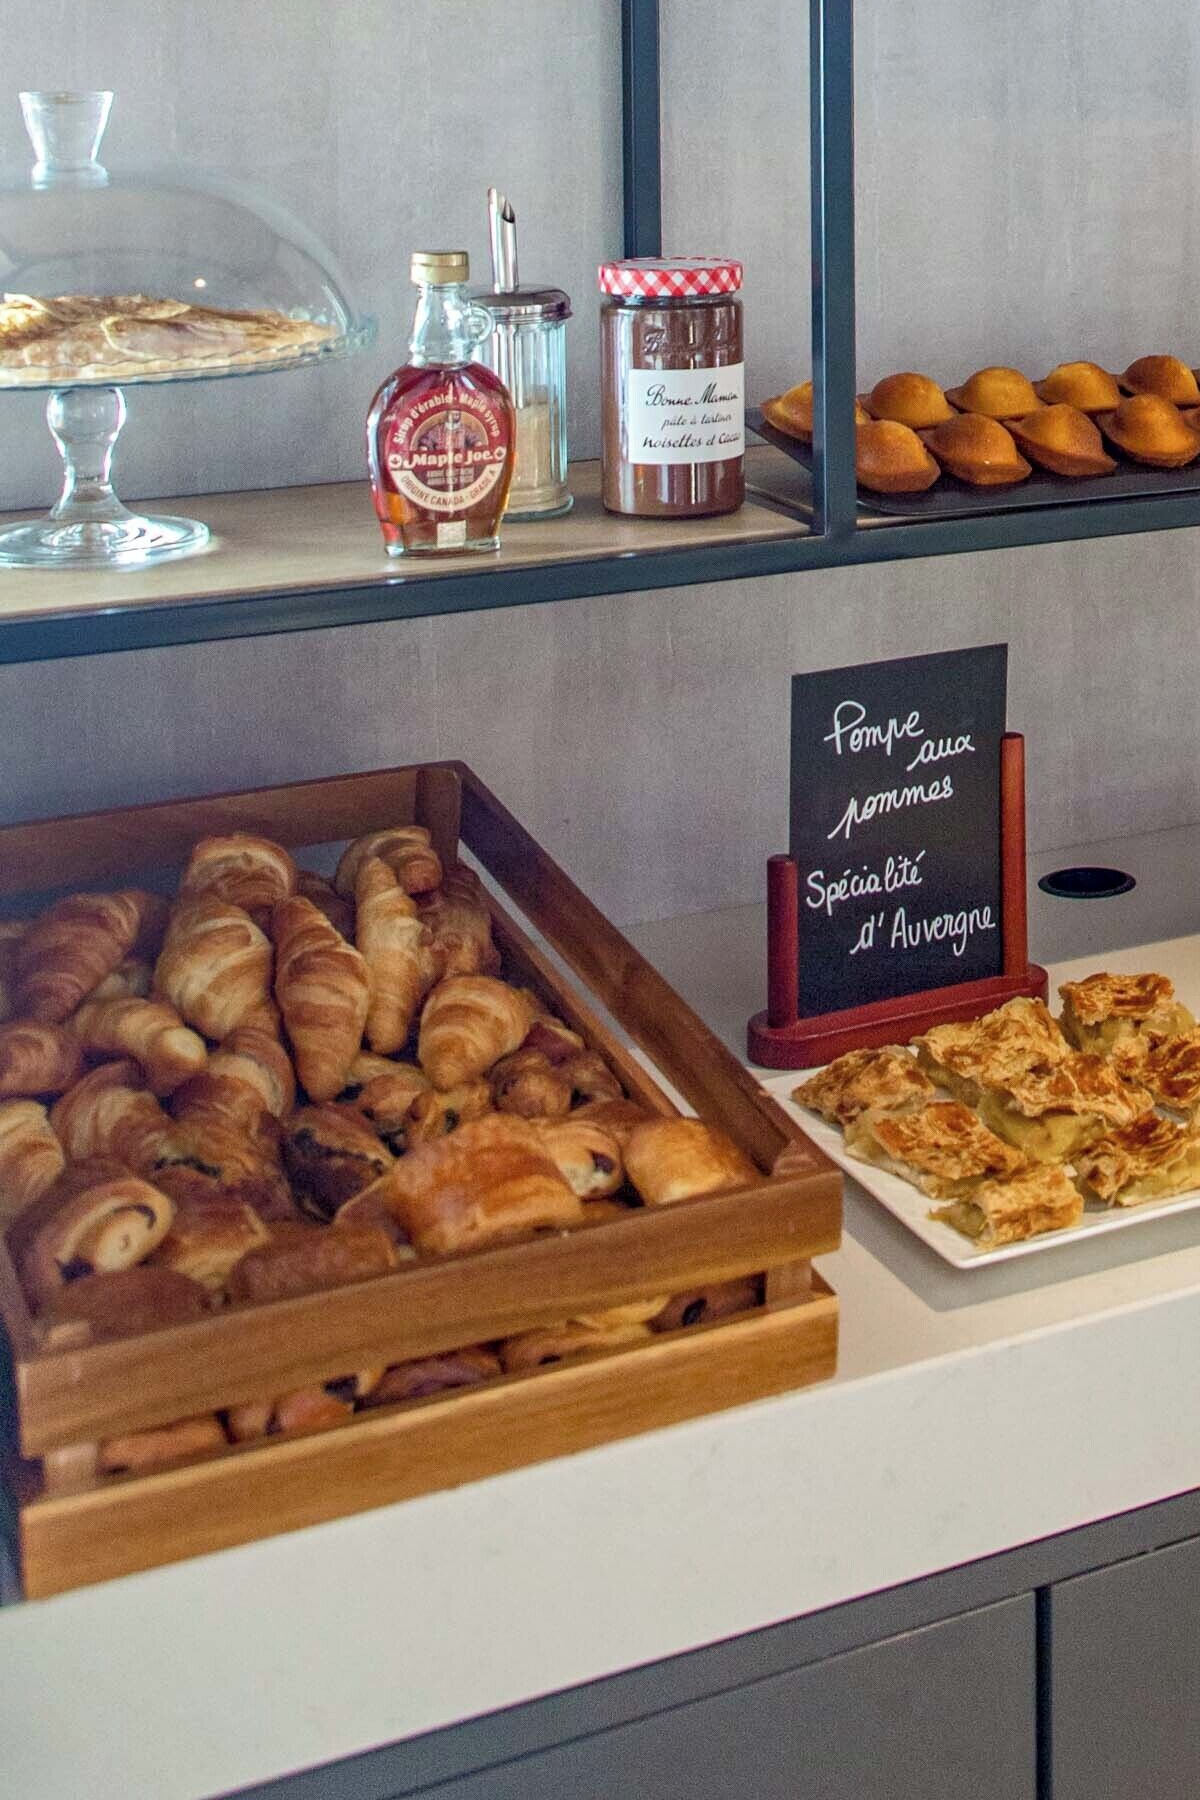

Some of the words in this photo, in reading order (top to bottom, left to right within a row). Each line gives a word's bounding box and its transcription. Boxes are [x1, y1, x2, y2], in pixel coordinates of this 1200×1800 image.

[646, 384, 691, 406] Bonne
[695, 382, 739, 405] Maman
[403, 453, 464, 468] Maple
[824, 700, 925, 757] Pompe
[906, 735, 976, 772] aux
[826, 775, 954, 840] pommes
[806, 850, 926, 917] Spécialité
